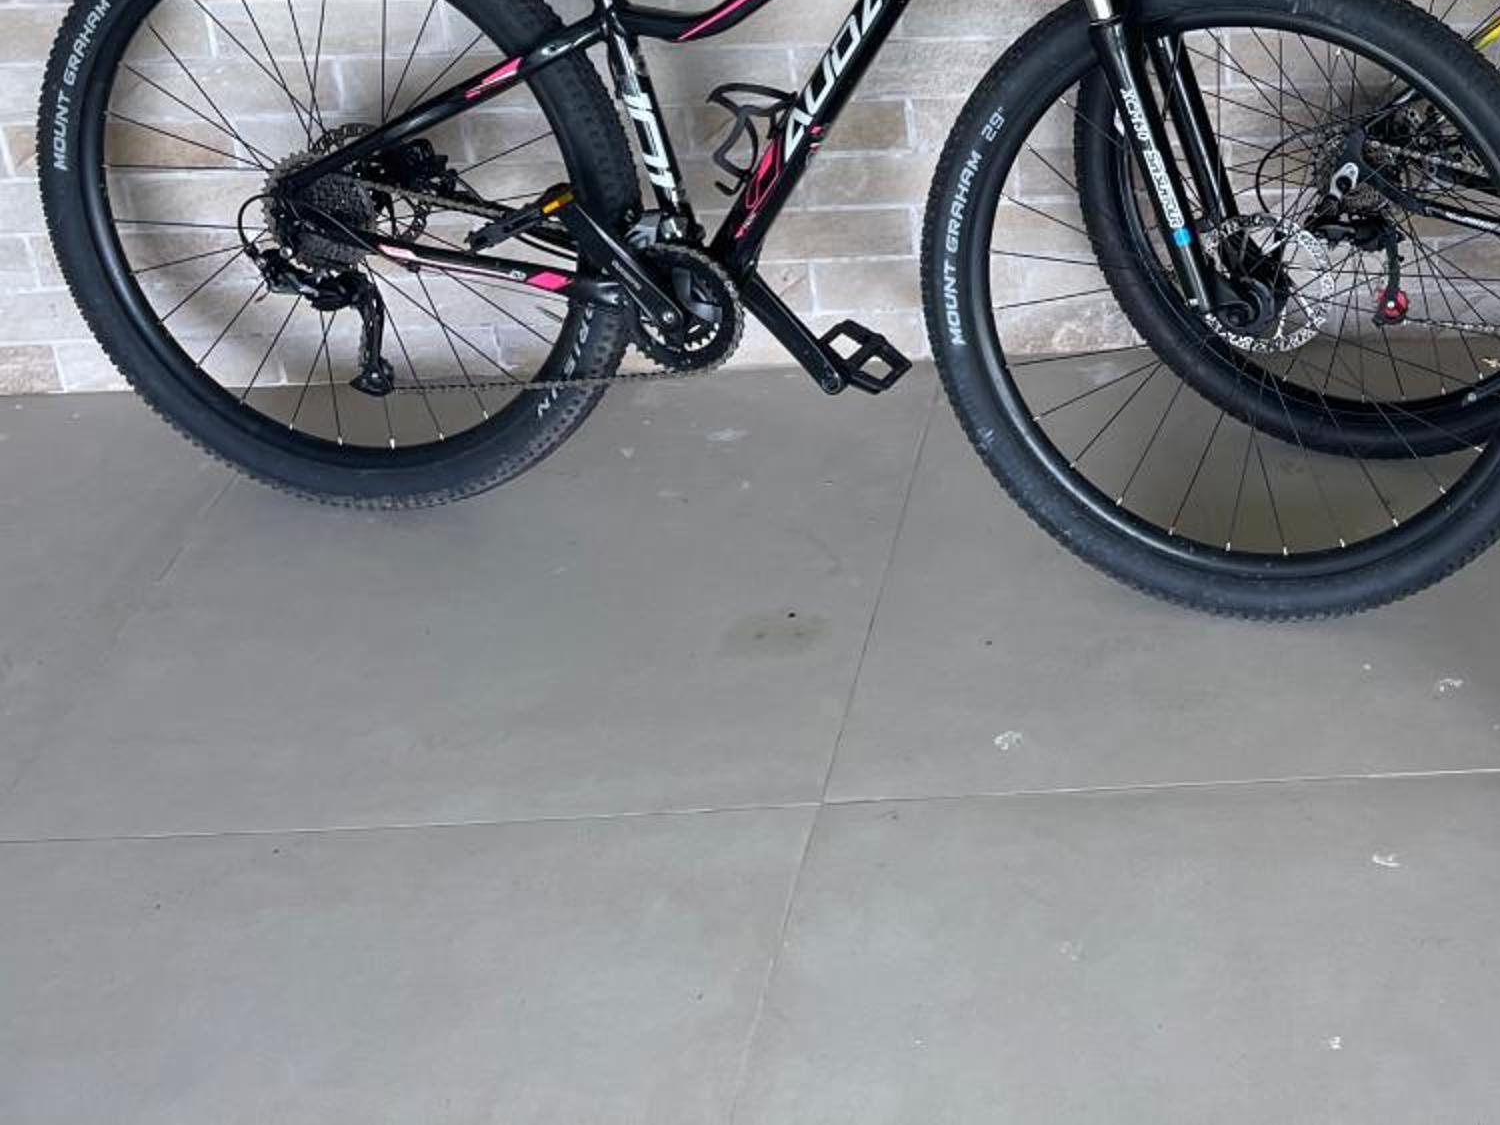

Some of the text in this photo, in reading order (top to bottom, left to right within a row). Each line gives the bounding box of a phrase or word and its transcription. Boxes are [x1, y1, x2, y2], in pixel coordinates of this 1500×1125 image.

[53, 89, 73, 172] MOUNT
[945, 149, 984, 254] GRAHAM
[943, 256, 968, 347] MOUNT
